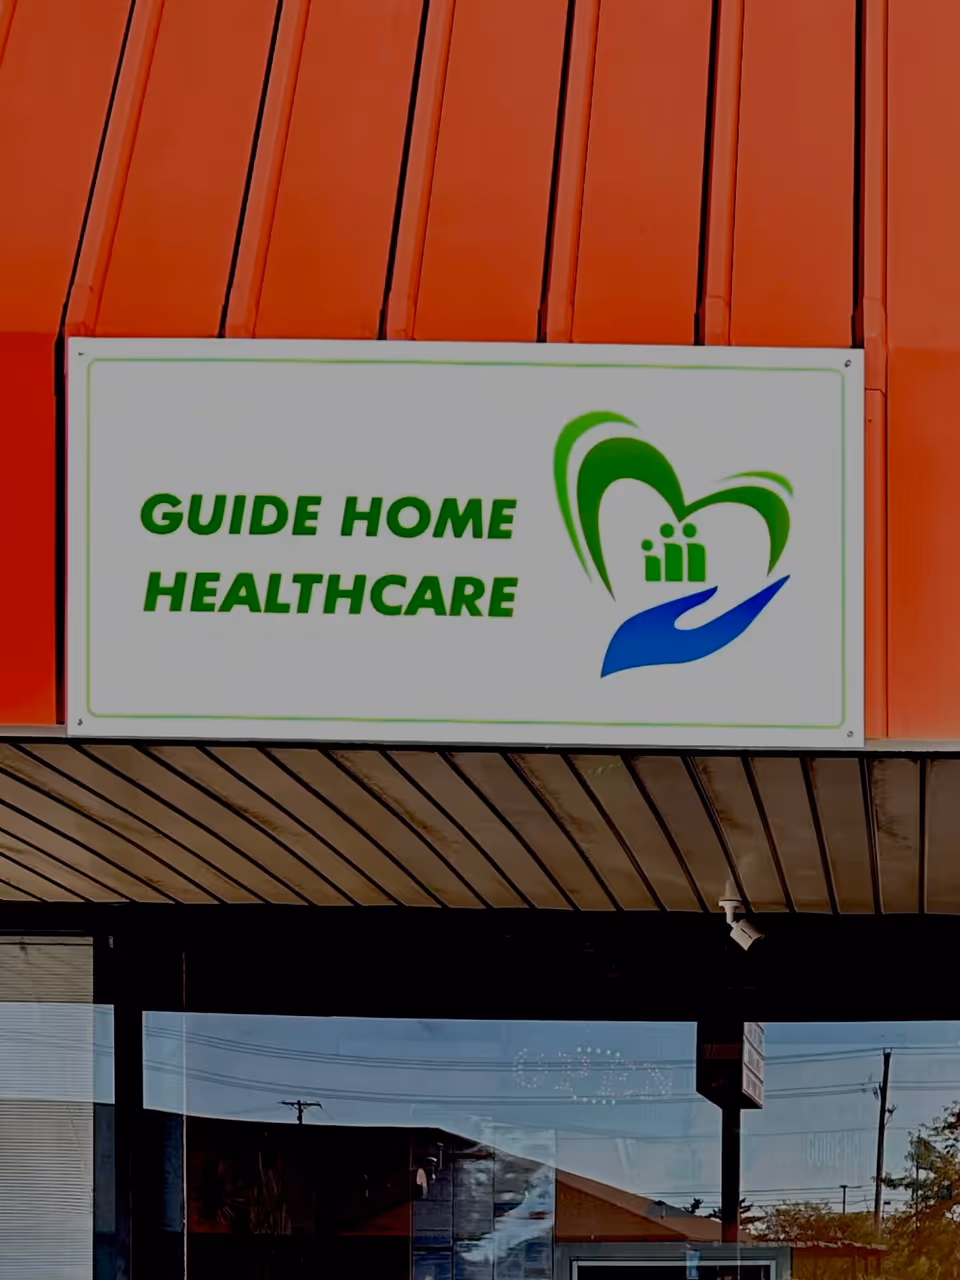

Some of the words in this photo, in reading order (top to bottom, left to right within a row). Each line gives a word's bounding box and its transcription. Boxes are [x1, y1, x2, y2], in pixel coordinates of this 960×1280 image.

[140, 492, 322, 536] GUIDE
[341, 495, 517, 540] HOME
[143, 571, 518, 619] HEALTHCARE
